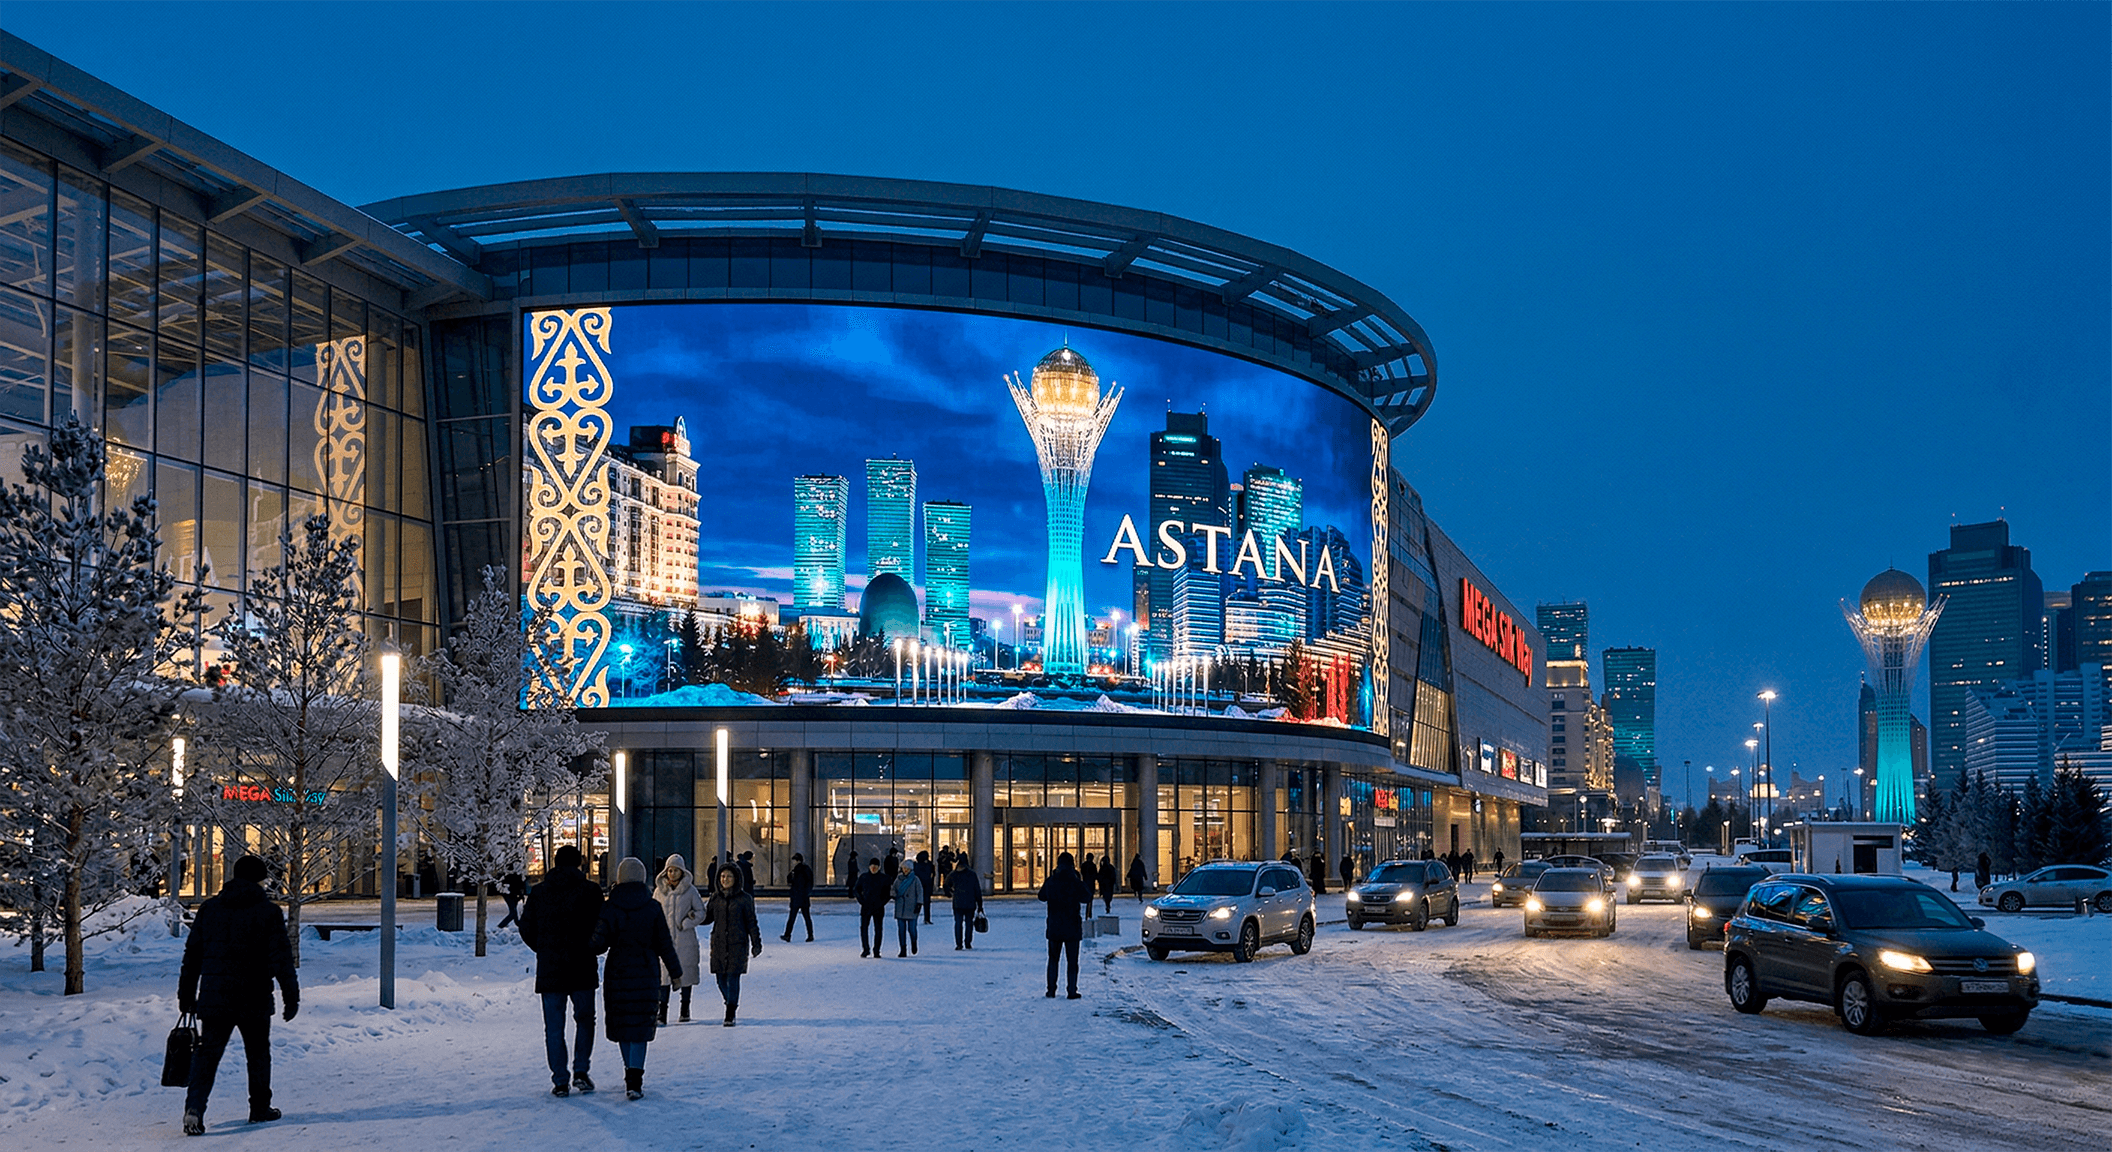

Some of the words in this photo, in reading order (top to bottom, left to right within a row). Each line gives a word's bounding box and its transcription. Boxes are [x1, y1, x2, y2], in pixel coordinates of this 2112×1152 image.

[1100, 513, 1341, 593] ASTANA
[1462, 577, 1498, 653] MEGA
[1515, 625, 1533, 687] Way
[223, 785, 271, 802] MEGA
